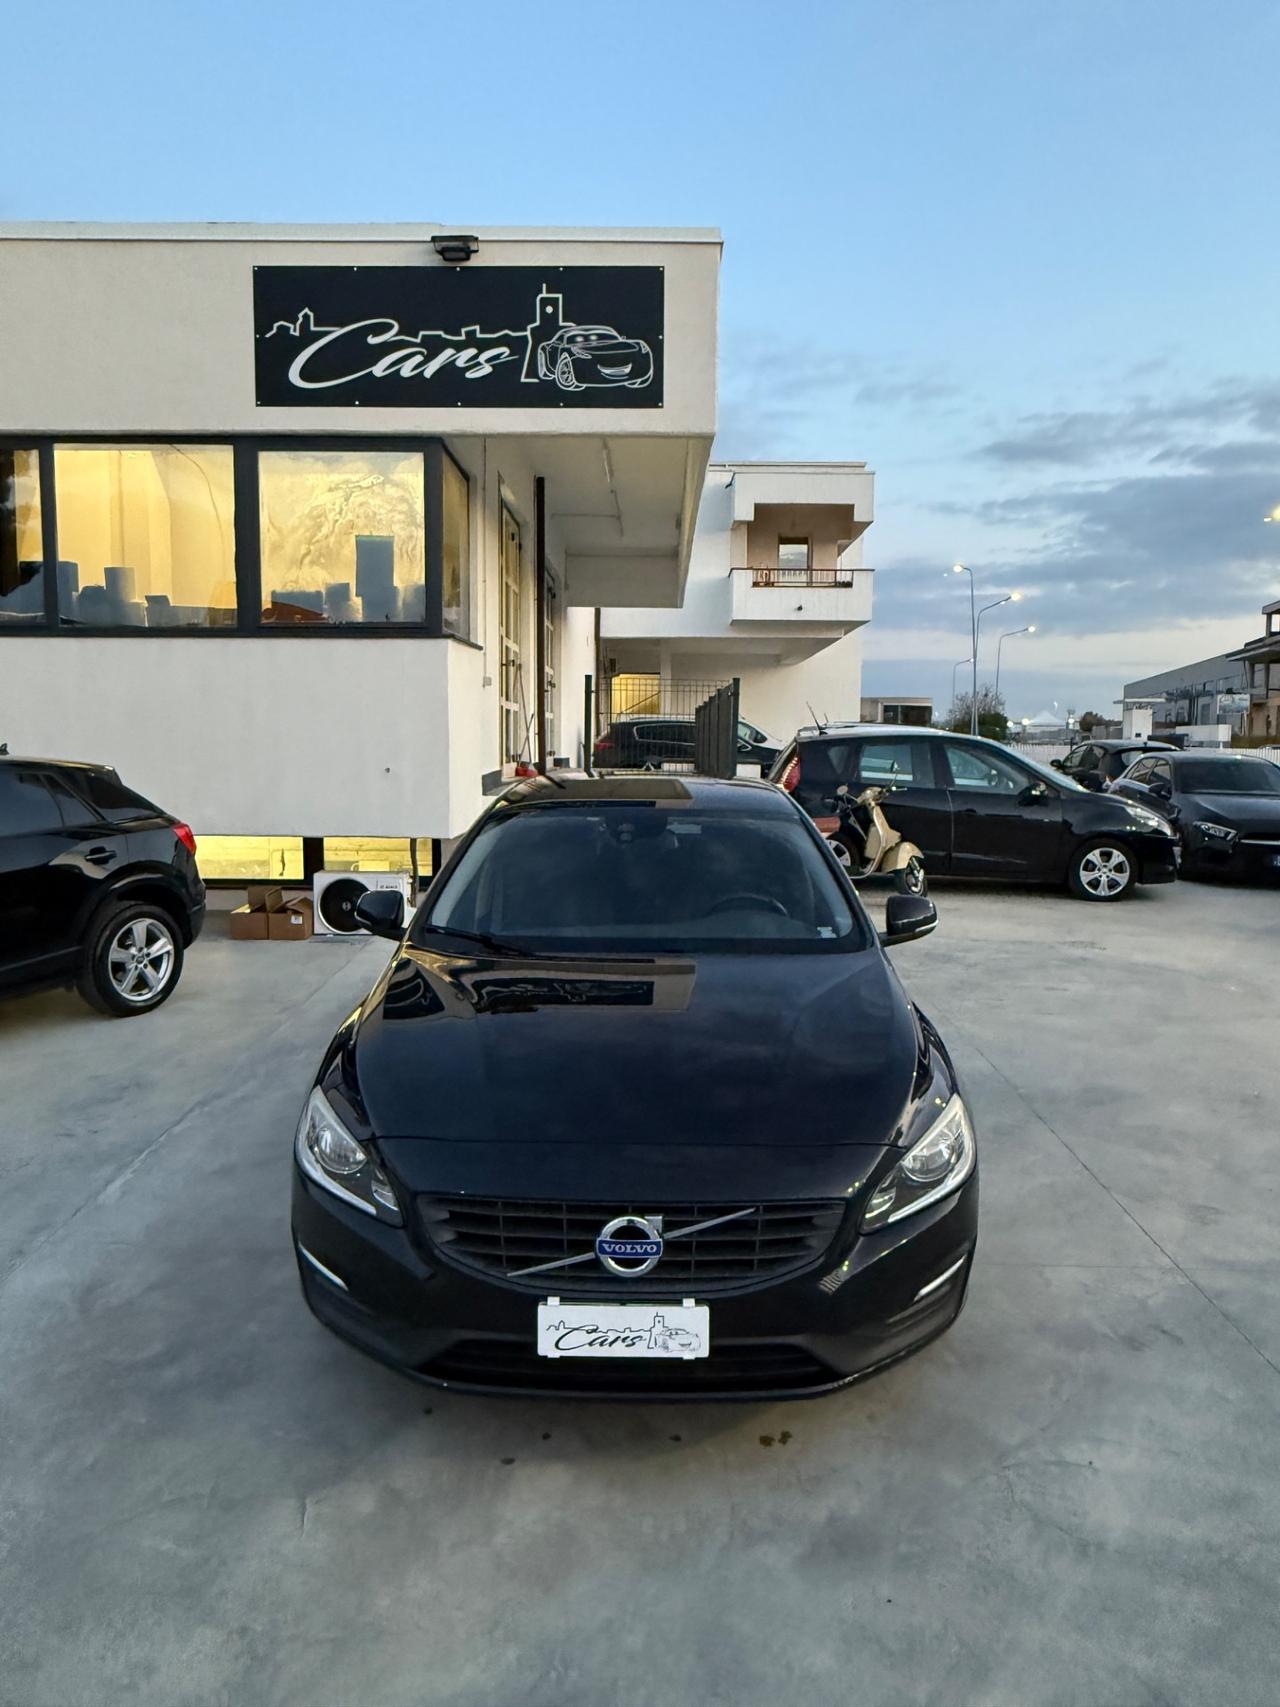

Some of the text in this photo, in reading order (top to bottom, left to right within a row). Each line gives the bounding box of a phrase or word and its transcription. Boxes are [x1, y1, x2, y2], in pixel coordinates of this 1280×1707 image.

[288, 318, 518, 388] Cars
[602, 1243, 657, 1253] VOLVO
[555, 1324, 647, 1350] Cars
